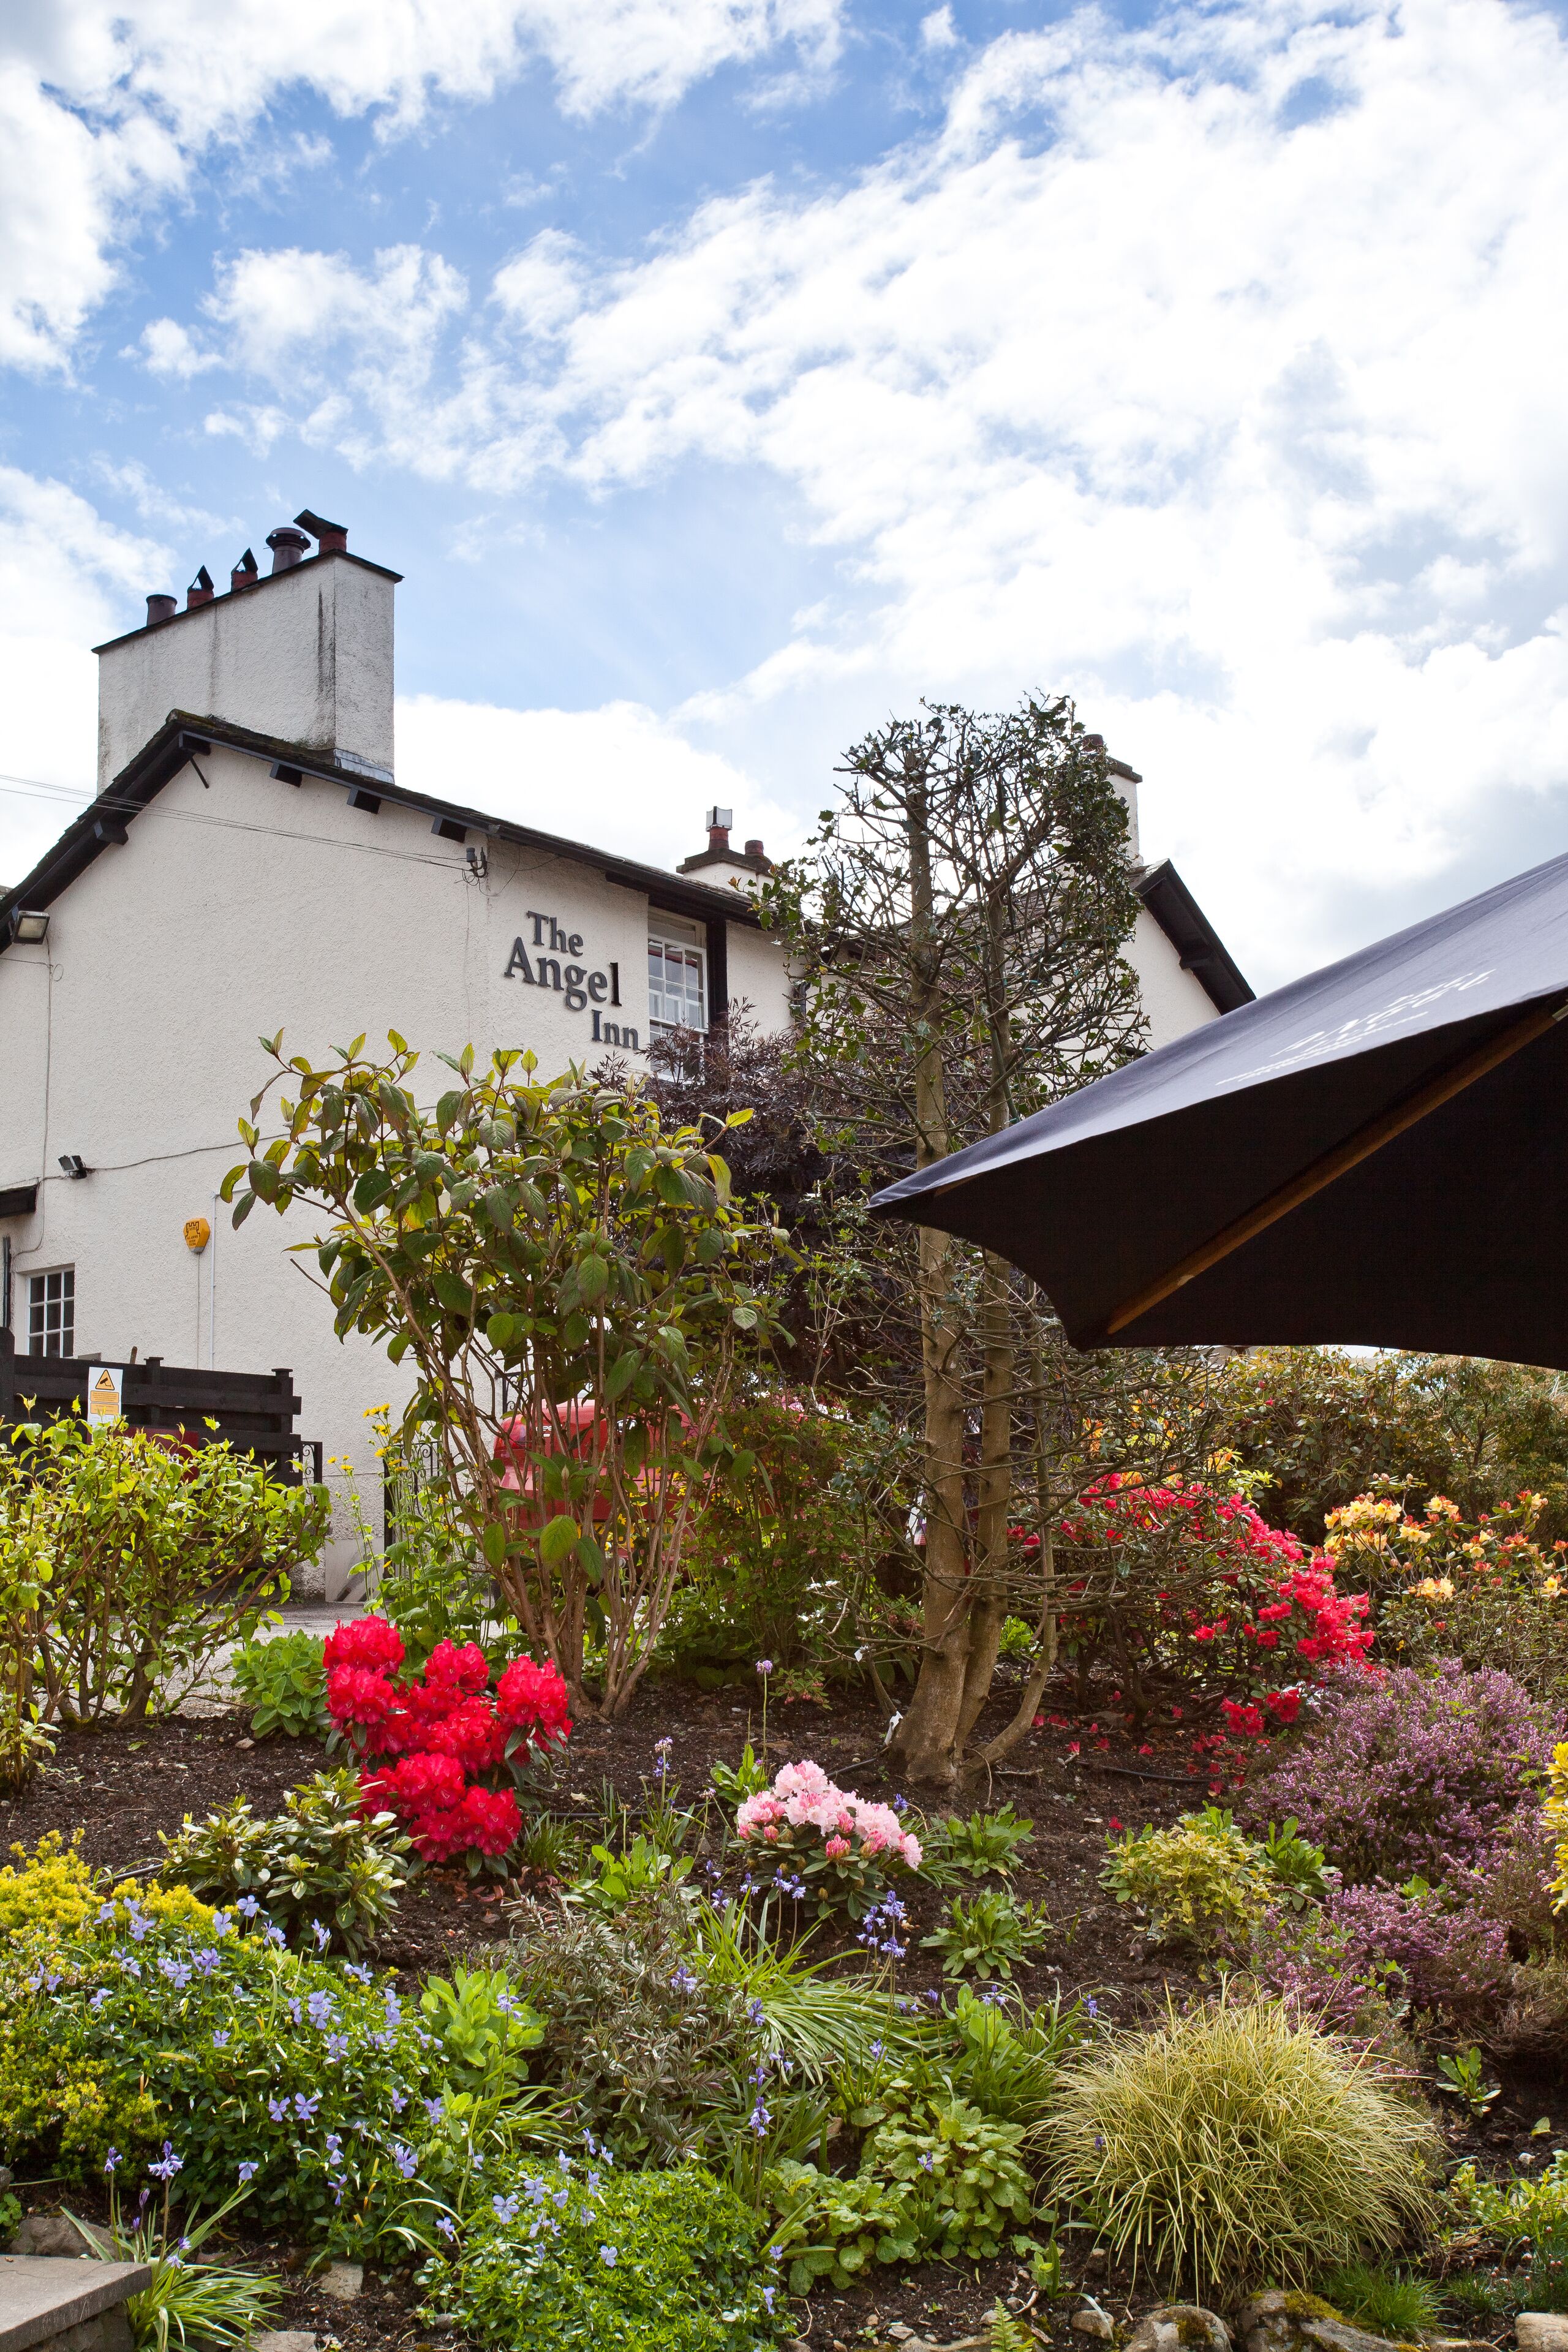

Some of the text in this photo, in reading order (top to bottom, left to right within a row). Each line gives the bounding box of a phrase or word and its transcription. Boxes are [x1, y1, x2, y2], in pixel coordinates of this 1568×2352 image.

[527, 910, 584, 957] The
[504, 937, 622, 1011] Angel
[591, 1009, 640, 1050] Inn
